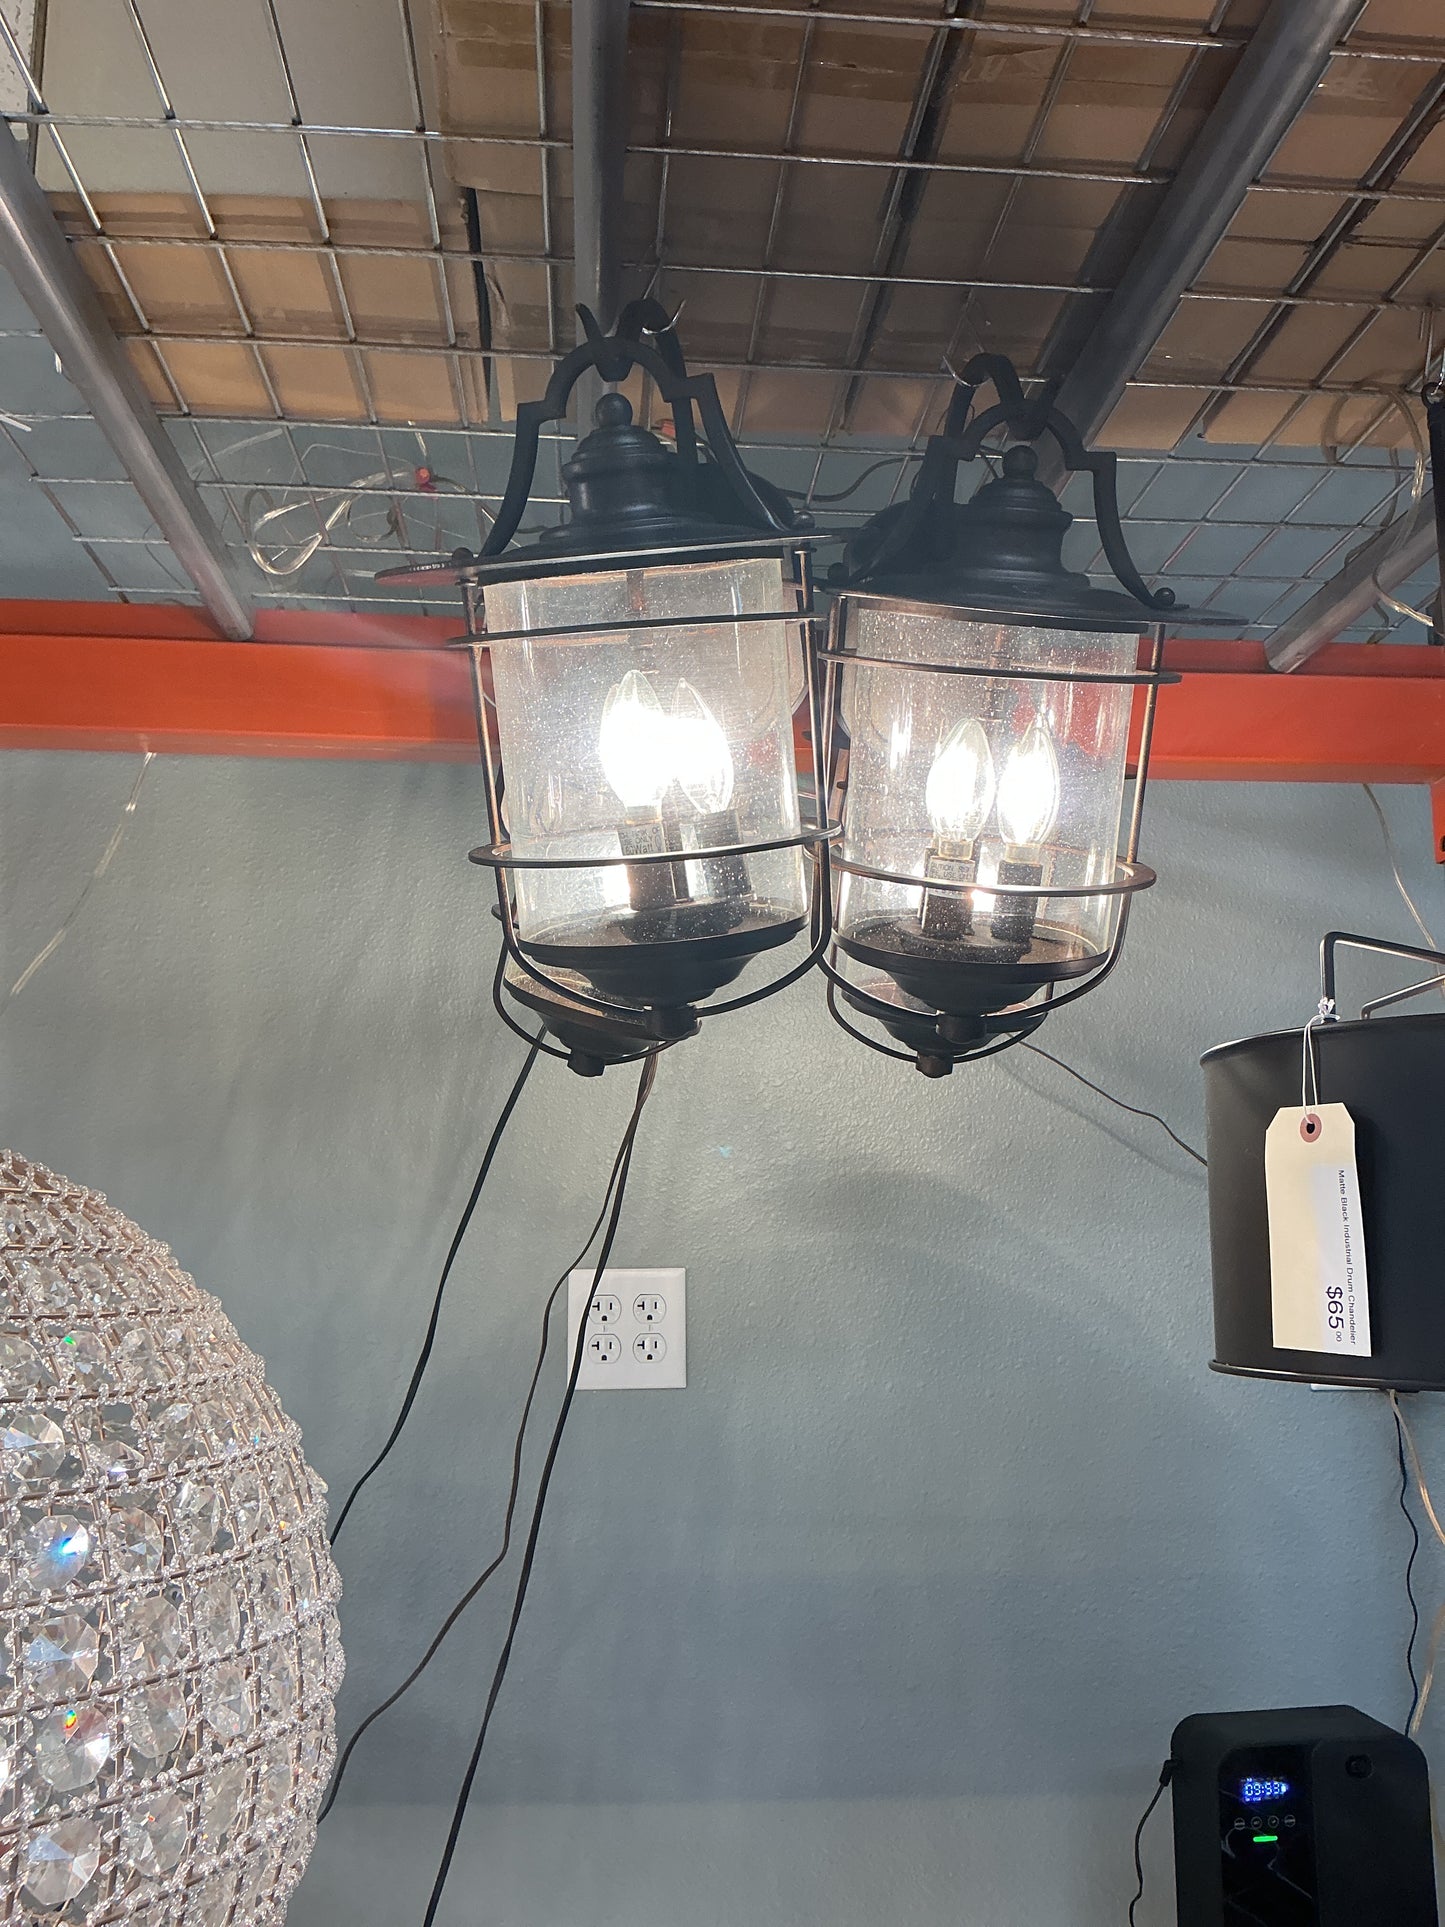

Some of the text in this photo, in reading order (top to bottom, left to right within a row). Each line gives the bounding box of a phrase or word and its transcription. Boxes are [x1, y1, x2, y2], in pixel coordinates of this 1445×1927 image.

[1338, 1169, 1346, 1195] Matte
[1340, 1197, 1349, 1222] Black
[1343, 1224, 1353, 1264] Industrial
[1325, 1286, 1344, 1329] $65
[1348, 1295, 1357, 1345] Chandelier
[1245, 1781, 1280, 1796] 09:53
